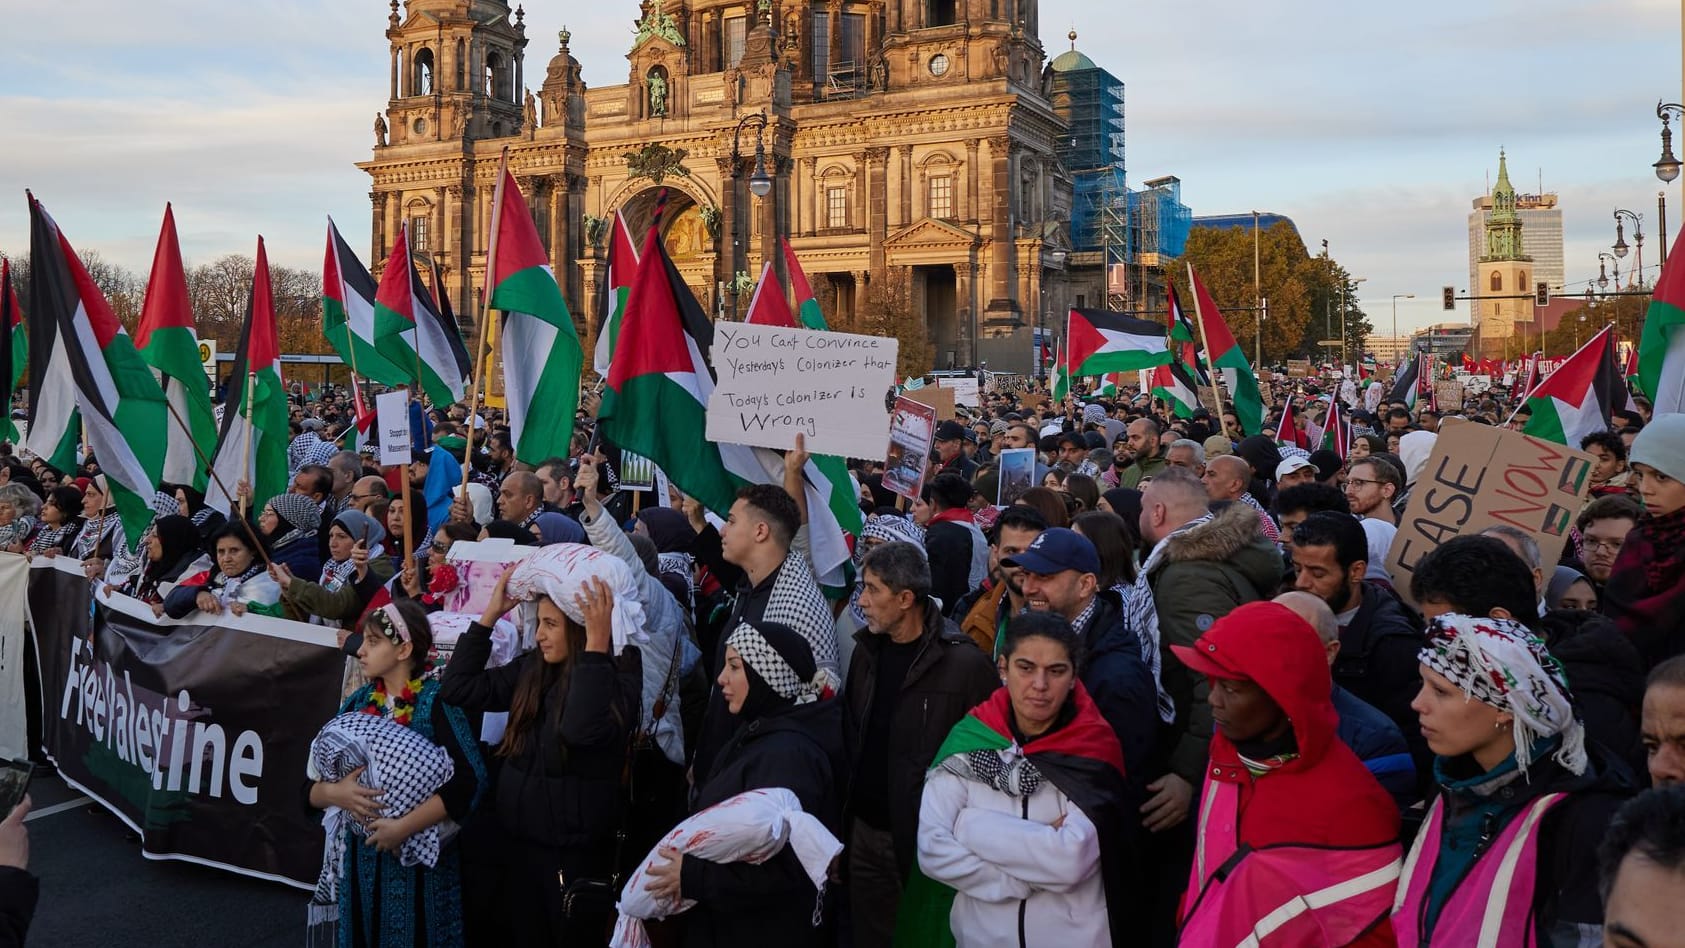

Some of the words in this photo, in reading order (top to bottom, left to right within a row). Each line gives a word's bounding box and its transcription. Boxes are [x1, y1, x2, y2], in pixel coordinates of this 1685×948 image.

[806, 335, 879, 350] Convince
[727, 357, 785, 379] Yesterday's
[797, 356, 857, 372] Colonizer
[863, 355, 892, 370] that
[722, 393, 769, 411] Today's
[740, 412, 816, 438] Wrong
[1488, 436, 1563, 533] NOW
[61, 635, 106, 742] Free
[105, 661, 264, 804] Palestine
